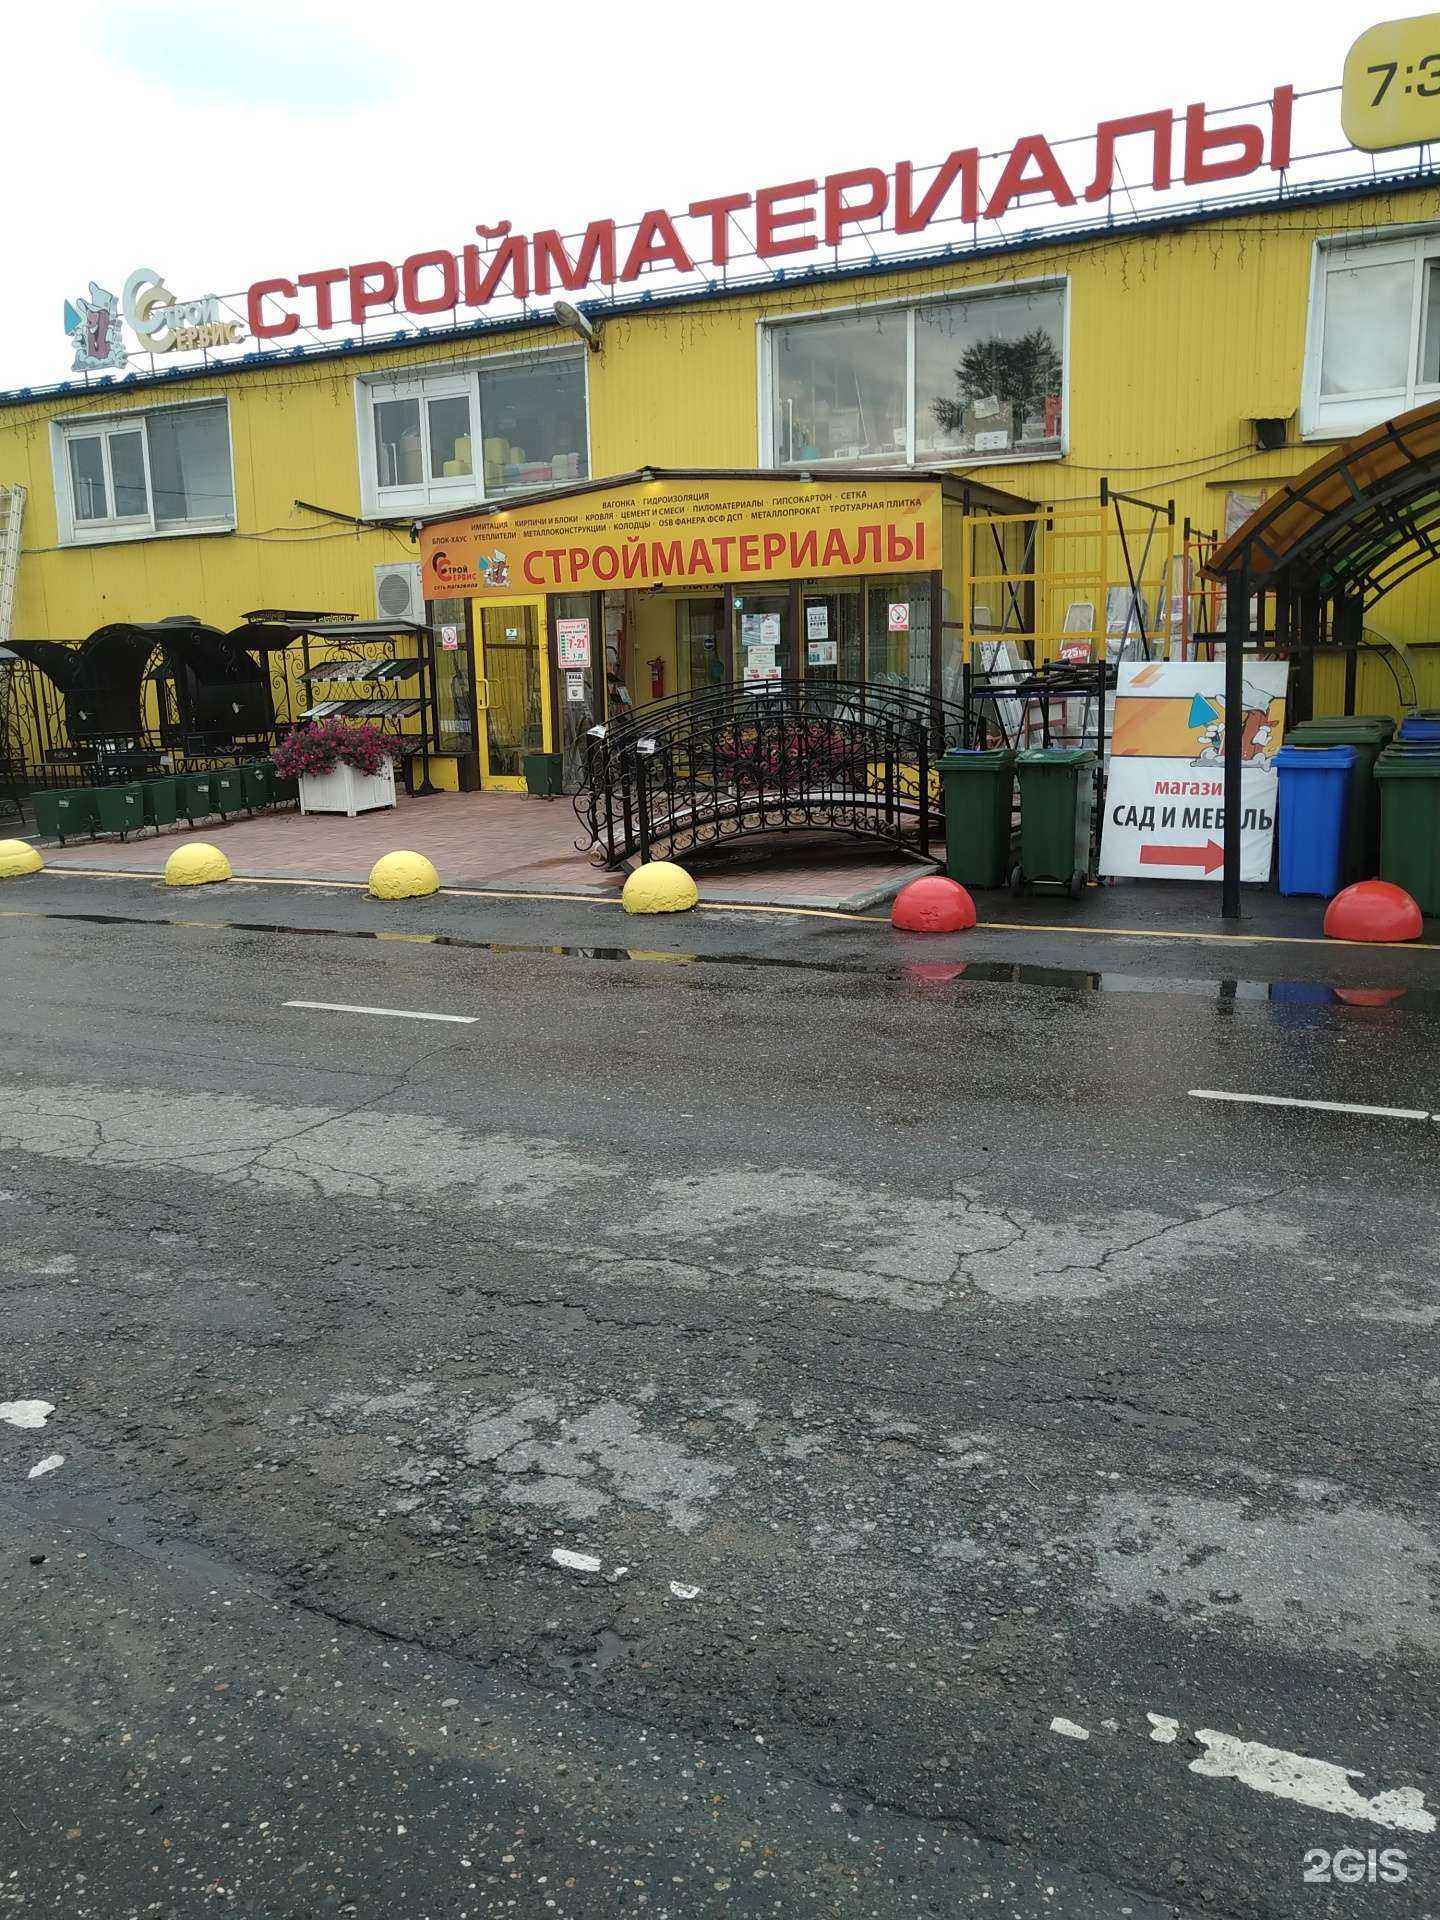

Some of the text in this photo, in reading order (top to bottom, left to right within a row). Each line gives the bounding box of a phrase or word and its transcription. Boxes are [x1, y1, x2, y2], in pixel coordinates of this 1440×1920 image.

[247, 84, 1293, 338] СТРОЙМАТЕРИАЛЫ
[432, 498, 922, 545] БЛОК-ХАУС УТЕПЛИТЕЛИ МЕТАЛЛОКОНСТРУКЦИИ КОЛОДЦЫ OSB ФАНЕРА ФСФ ДСП МЕТАЛЛОПРОКАТ ТРОТУАРНАЯ ПЛИТКА
[471, 490, 867, 531] ИМИТАЦИЯ КИРПИЧИ И БЛОКИ КРОВЛЯ ЦЕМЕНТ И СМЕСИ ПИЛОМАТЕРИАЛЫ ГИПСОКАРТОН СЕТКА
[602, 492, 710, 510] ВАГОНКА ГИДРОИЗОЛЯЦИЯ
[523, 522, 925, 585] СТРОЙМАТЕРИАЛЫ
[1154, 780, 1225, 796] магази
[1112, 804, 1273, 831] САД И МЕБЛЬ
